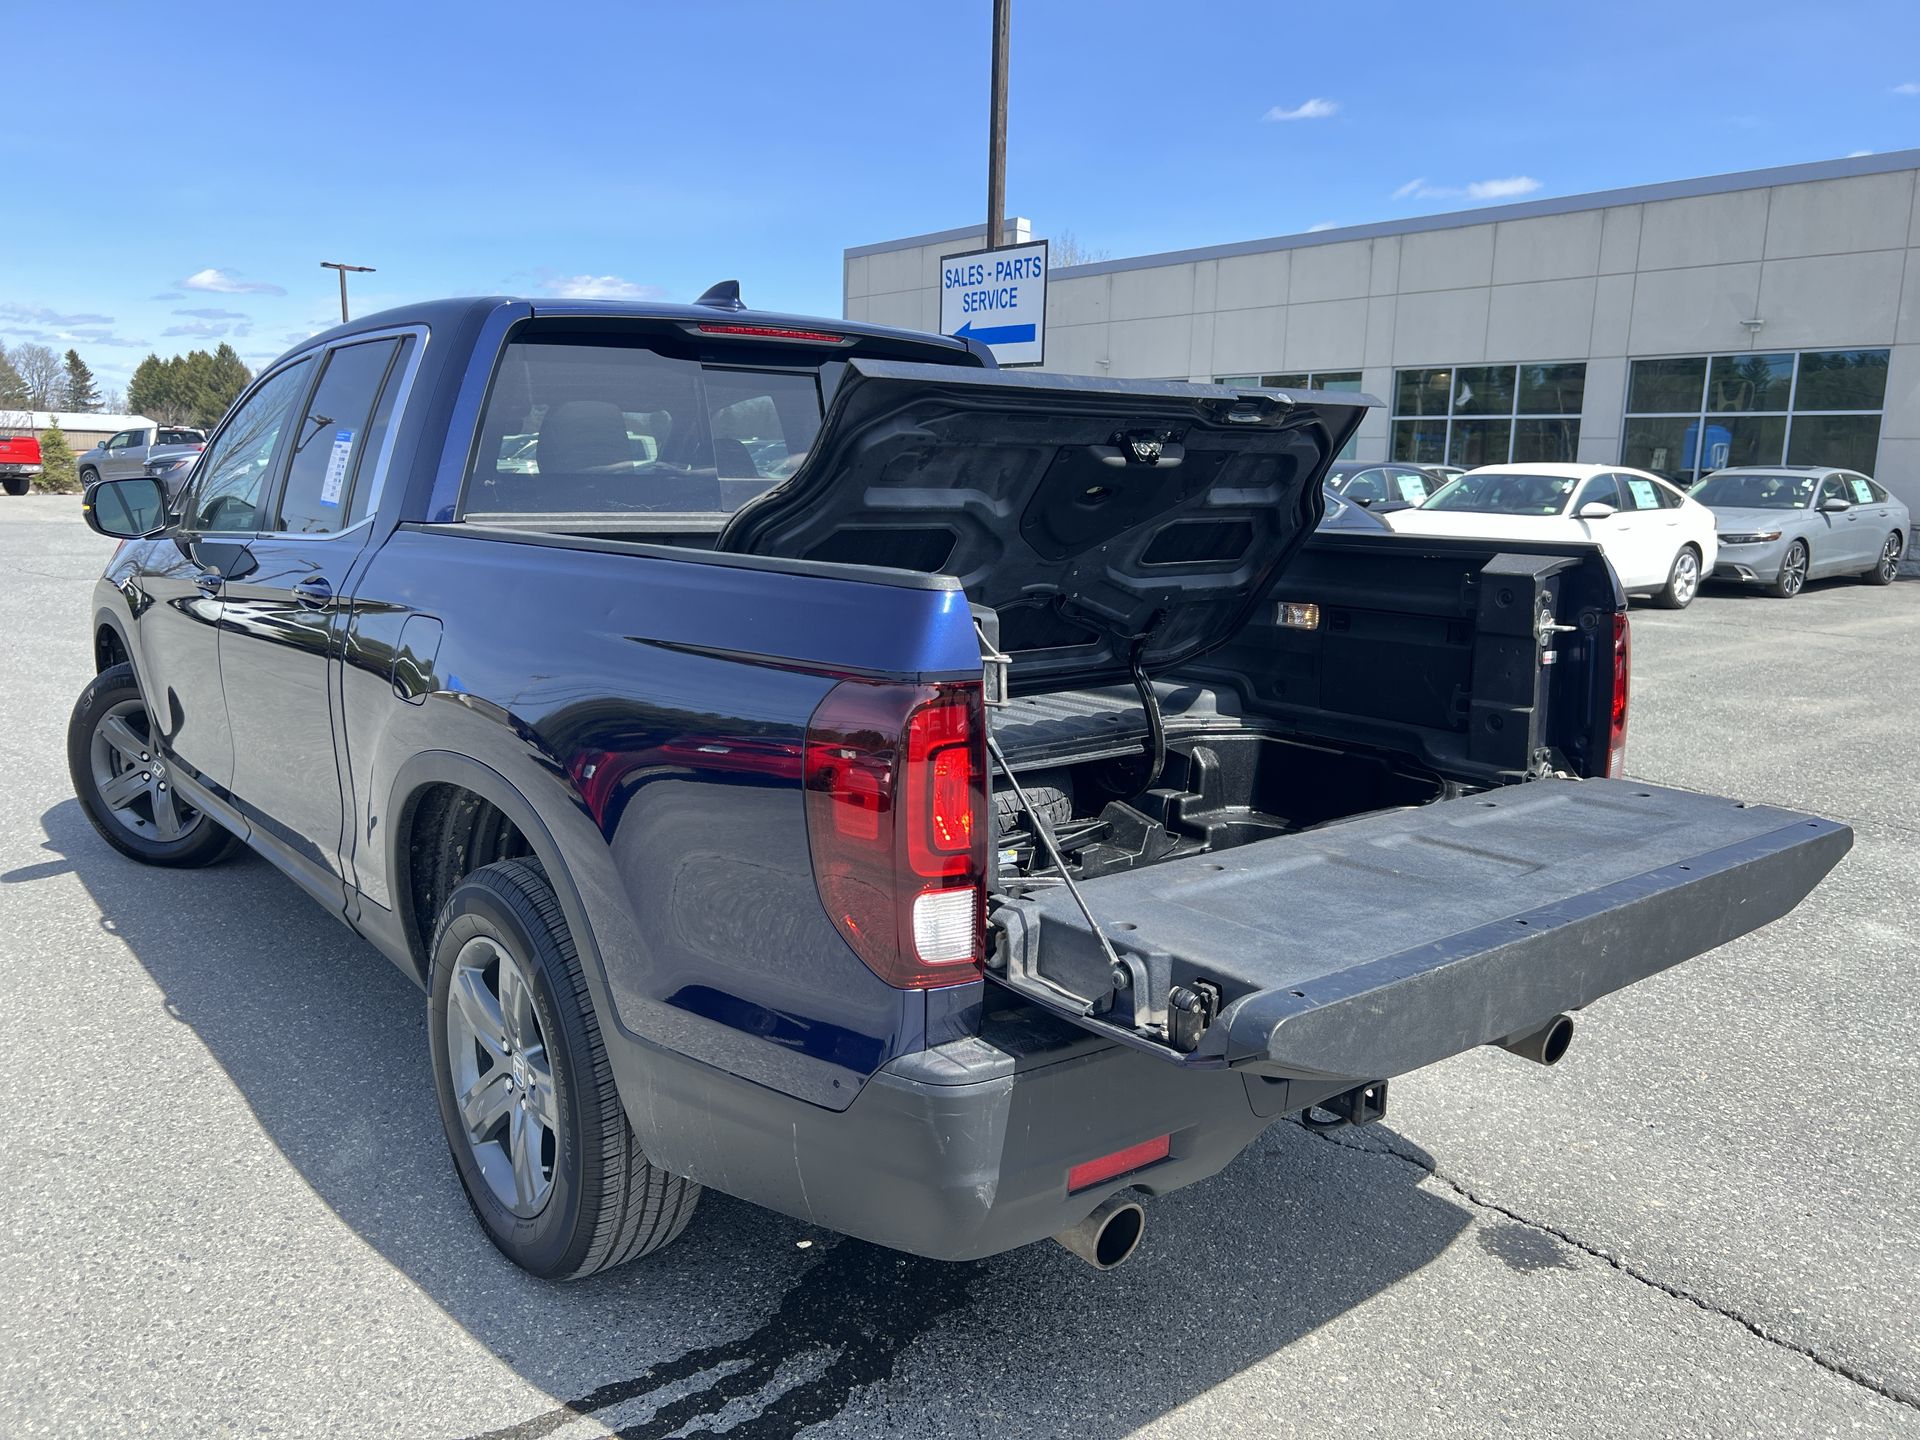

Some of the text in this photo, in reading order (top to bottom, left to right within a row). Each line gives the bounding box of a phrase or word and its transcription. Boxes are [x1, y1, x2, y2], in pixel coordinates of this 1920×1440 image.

[945, 264, 984, 289] SALES
[996, 256, 1041, 282] PARTS
[962, 287, 1018, 312] SERVICE
[538, 991, 555, 1041] TRAIL
